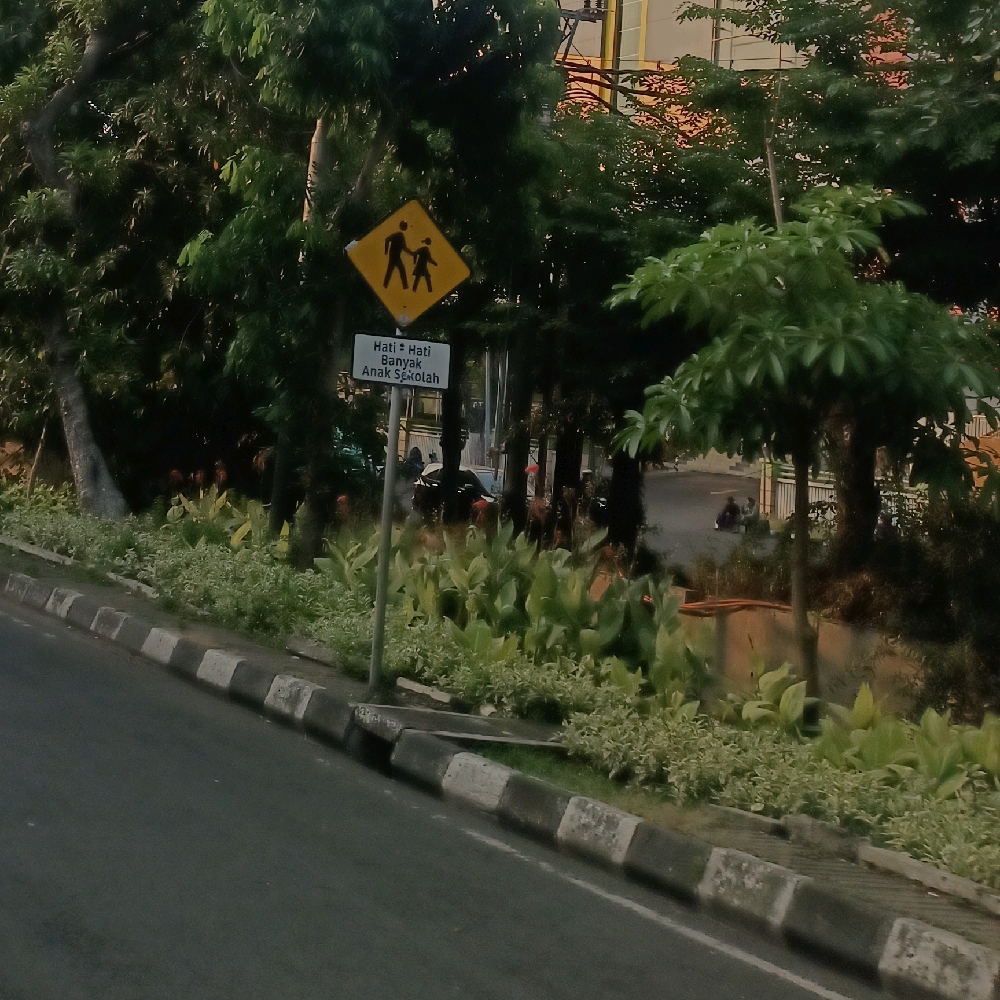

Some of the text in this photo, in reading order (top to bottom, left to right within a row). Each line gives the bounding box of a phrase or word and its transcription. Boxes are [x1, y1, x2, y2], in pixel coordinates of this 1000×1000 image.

[373, 340, 396, 353] Hati
[408, 344, 431, 357] Hati
[381, 354, 422, 370] Banyak
[361, 365, 440, 385] Anak Sekolah
